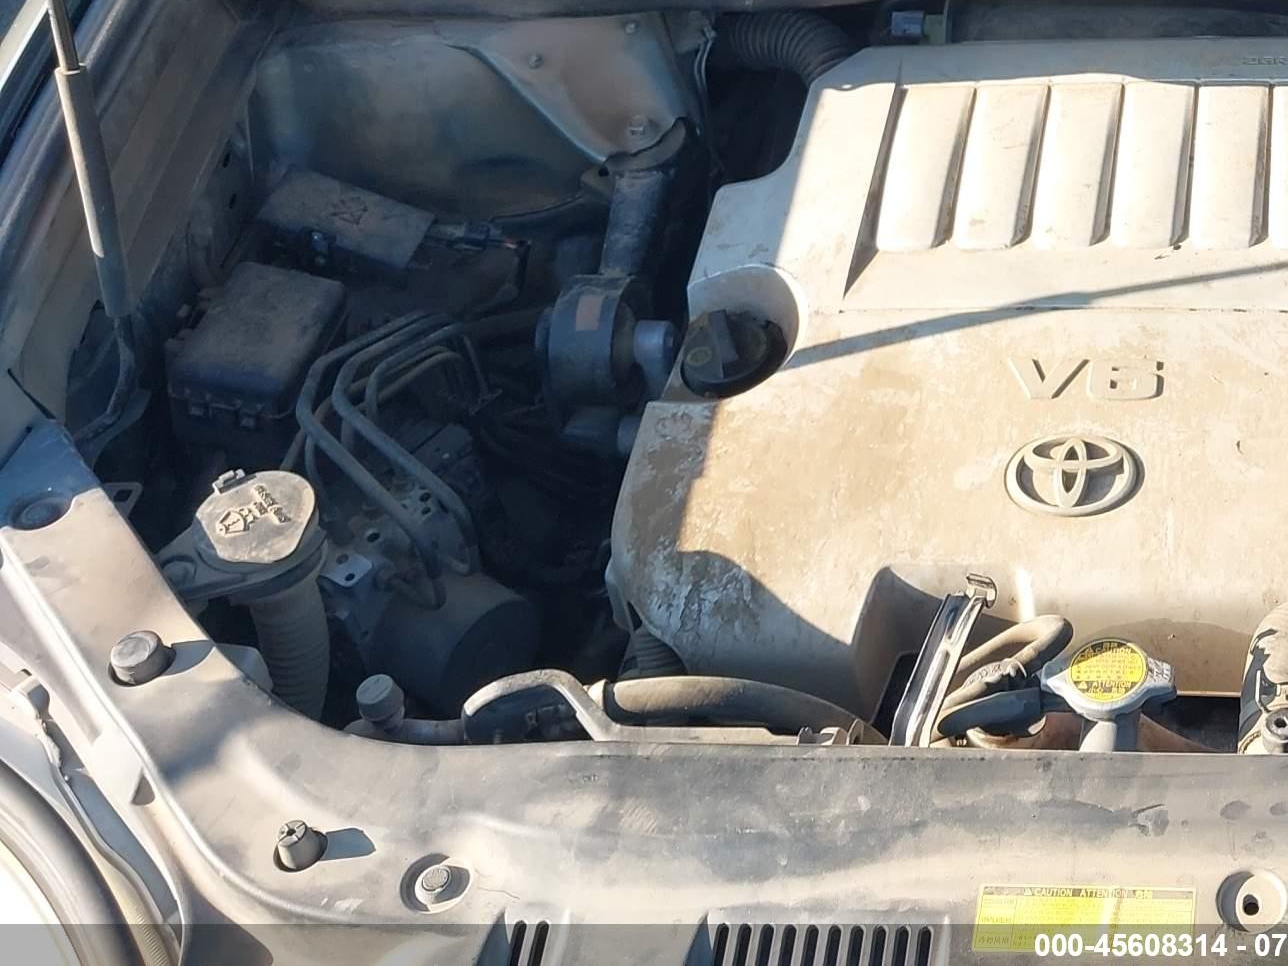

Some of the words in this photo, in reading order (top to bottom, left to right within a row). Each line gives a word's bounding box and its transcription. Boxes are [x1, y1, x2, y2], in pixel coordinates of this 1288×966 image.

[1007, 357, 1165, 401] V6
[1034, 888, 1073, 898] CAUTION
[1079, 888, 1128, 899] ATTENTION
